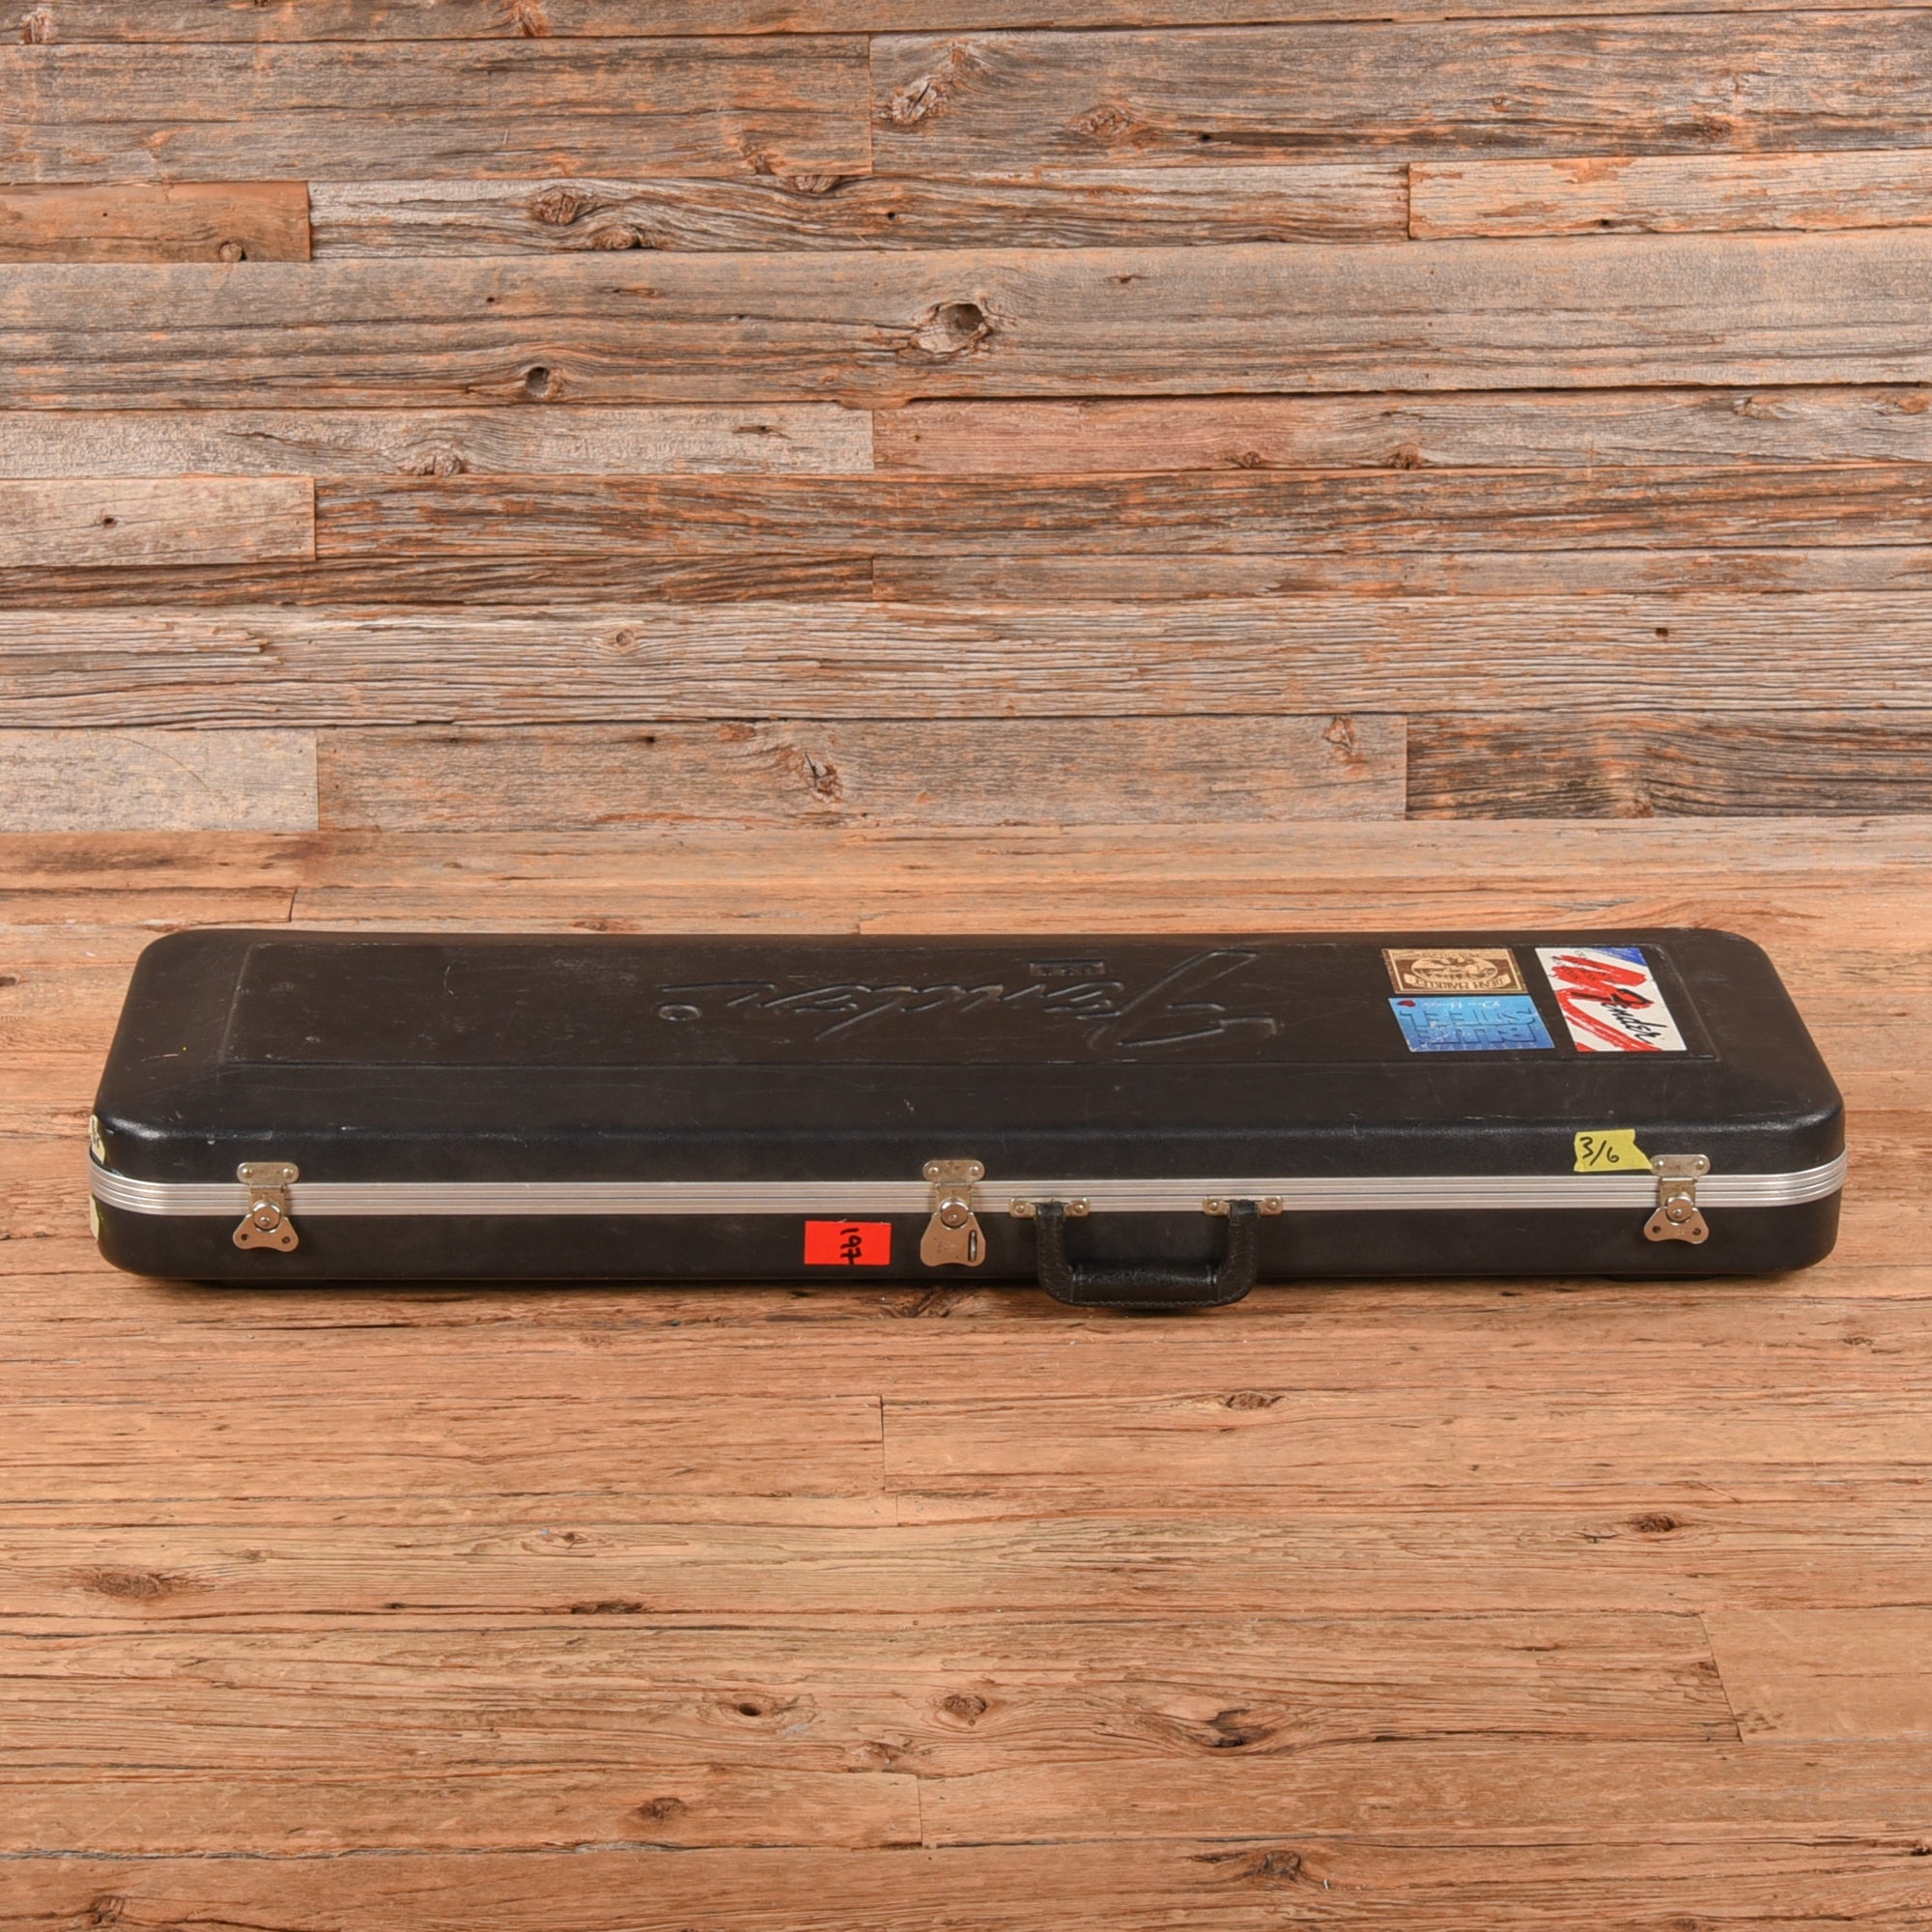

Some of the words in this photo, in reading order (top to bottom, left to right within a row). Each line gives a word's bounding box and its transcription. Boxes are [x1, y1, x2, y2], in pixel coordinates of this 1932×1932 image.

[1414, 978, 1470, 990] MARKLEY
[1474, 978, 1505, 990] DEAN
[661, 951, 1278, 1048] Fender
[1399, 1008, 1536, 1025] STEEL
[1417, 1024, 1537, 1044] BLUE
[1579, 1136, 1620, 1166] 3/6
